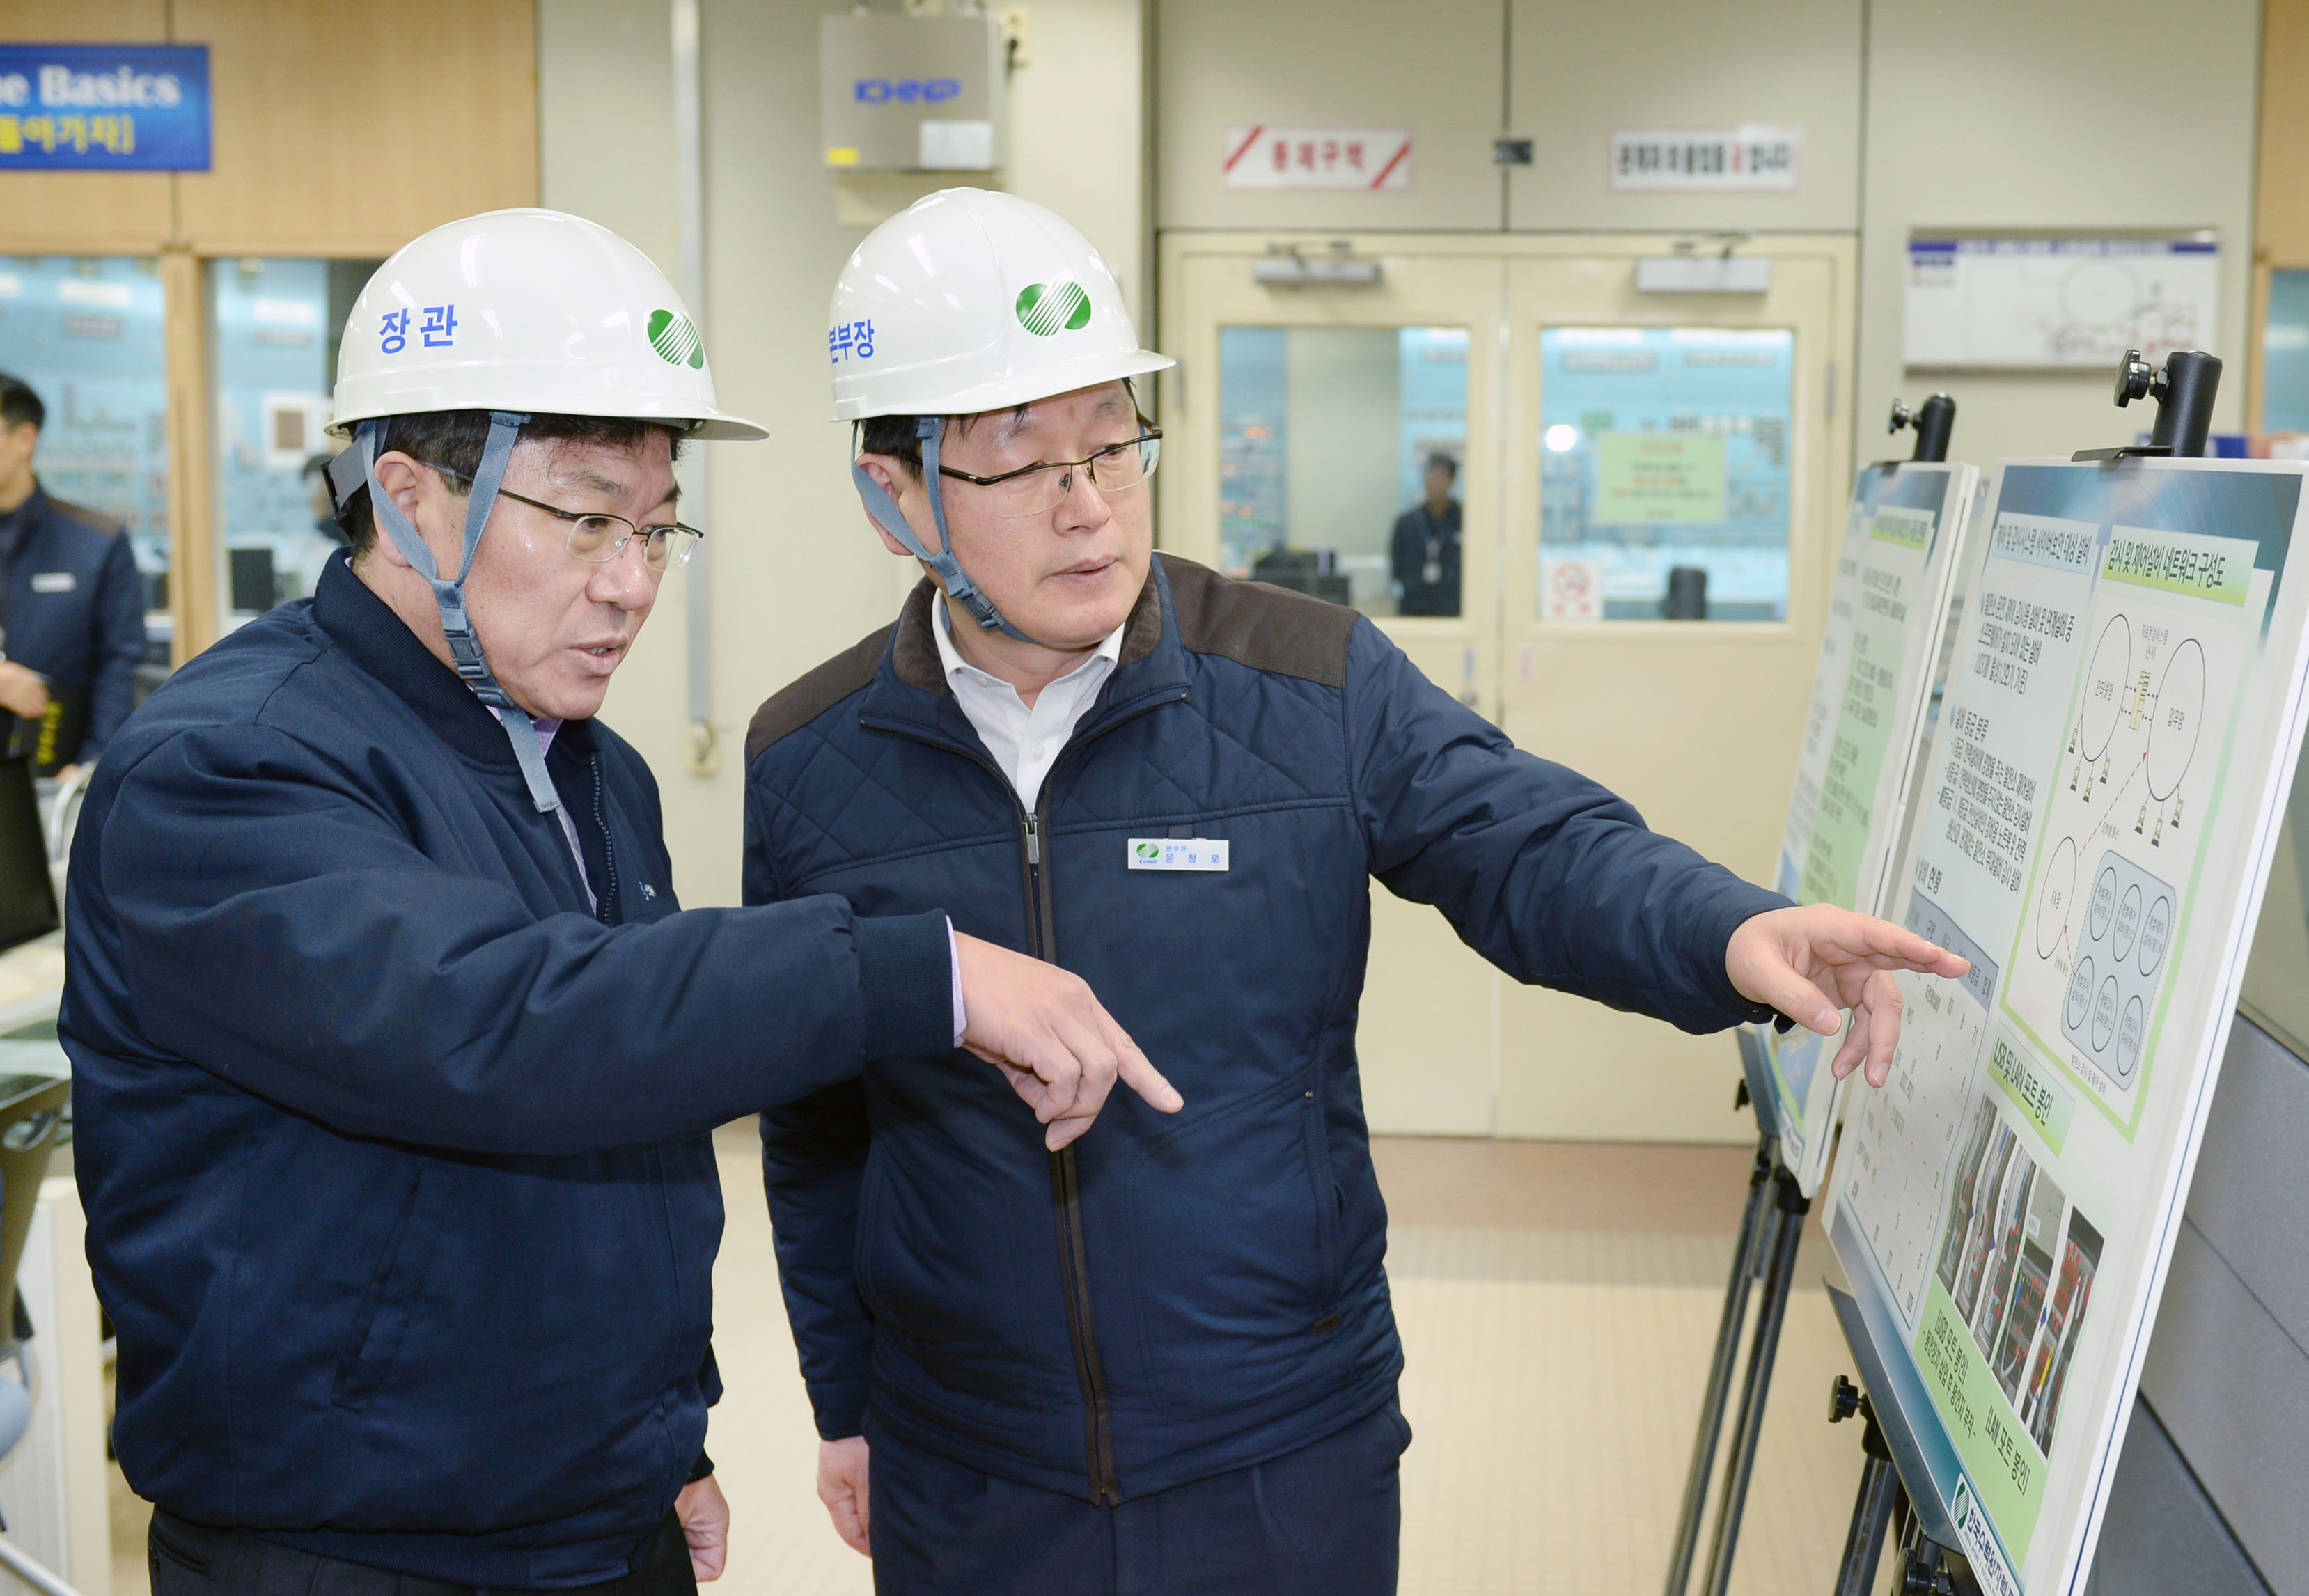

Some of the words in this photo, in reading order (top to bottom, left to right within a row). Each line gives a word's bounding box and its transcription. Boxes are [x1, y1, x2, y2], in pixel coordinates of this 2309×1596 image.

[0, 72, 29, 107] e
[40, 64, 182, 107] Basics
[2108, 539, 2126, 572] 감시
[2122, 541, 2135, 574] 및
[2131, 542, 2166, 579] 제어설비
[2163, 547, 2198, 584] 네트워크
[2198, 553, 2226, 588] 구성도
[1927, 866, 1943, 895] 현황
[1994, 1038, 2007, 1070] USB
[2003, 1049, 2014, 1083] 및
[2010, 1057, 2026, 1093] LAN
[2022, 1072, 2039, 1109] 포트
[2035, 1084, 2053, 1127] 봉인
[1944, 1328, 1958, 1362] 포트
[1998, 1427, 2014, 1467] 포트
